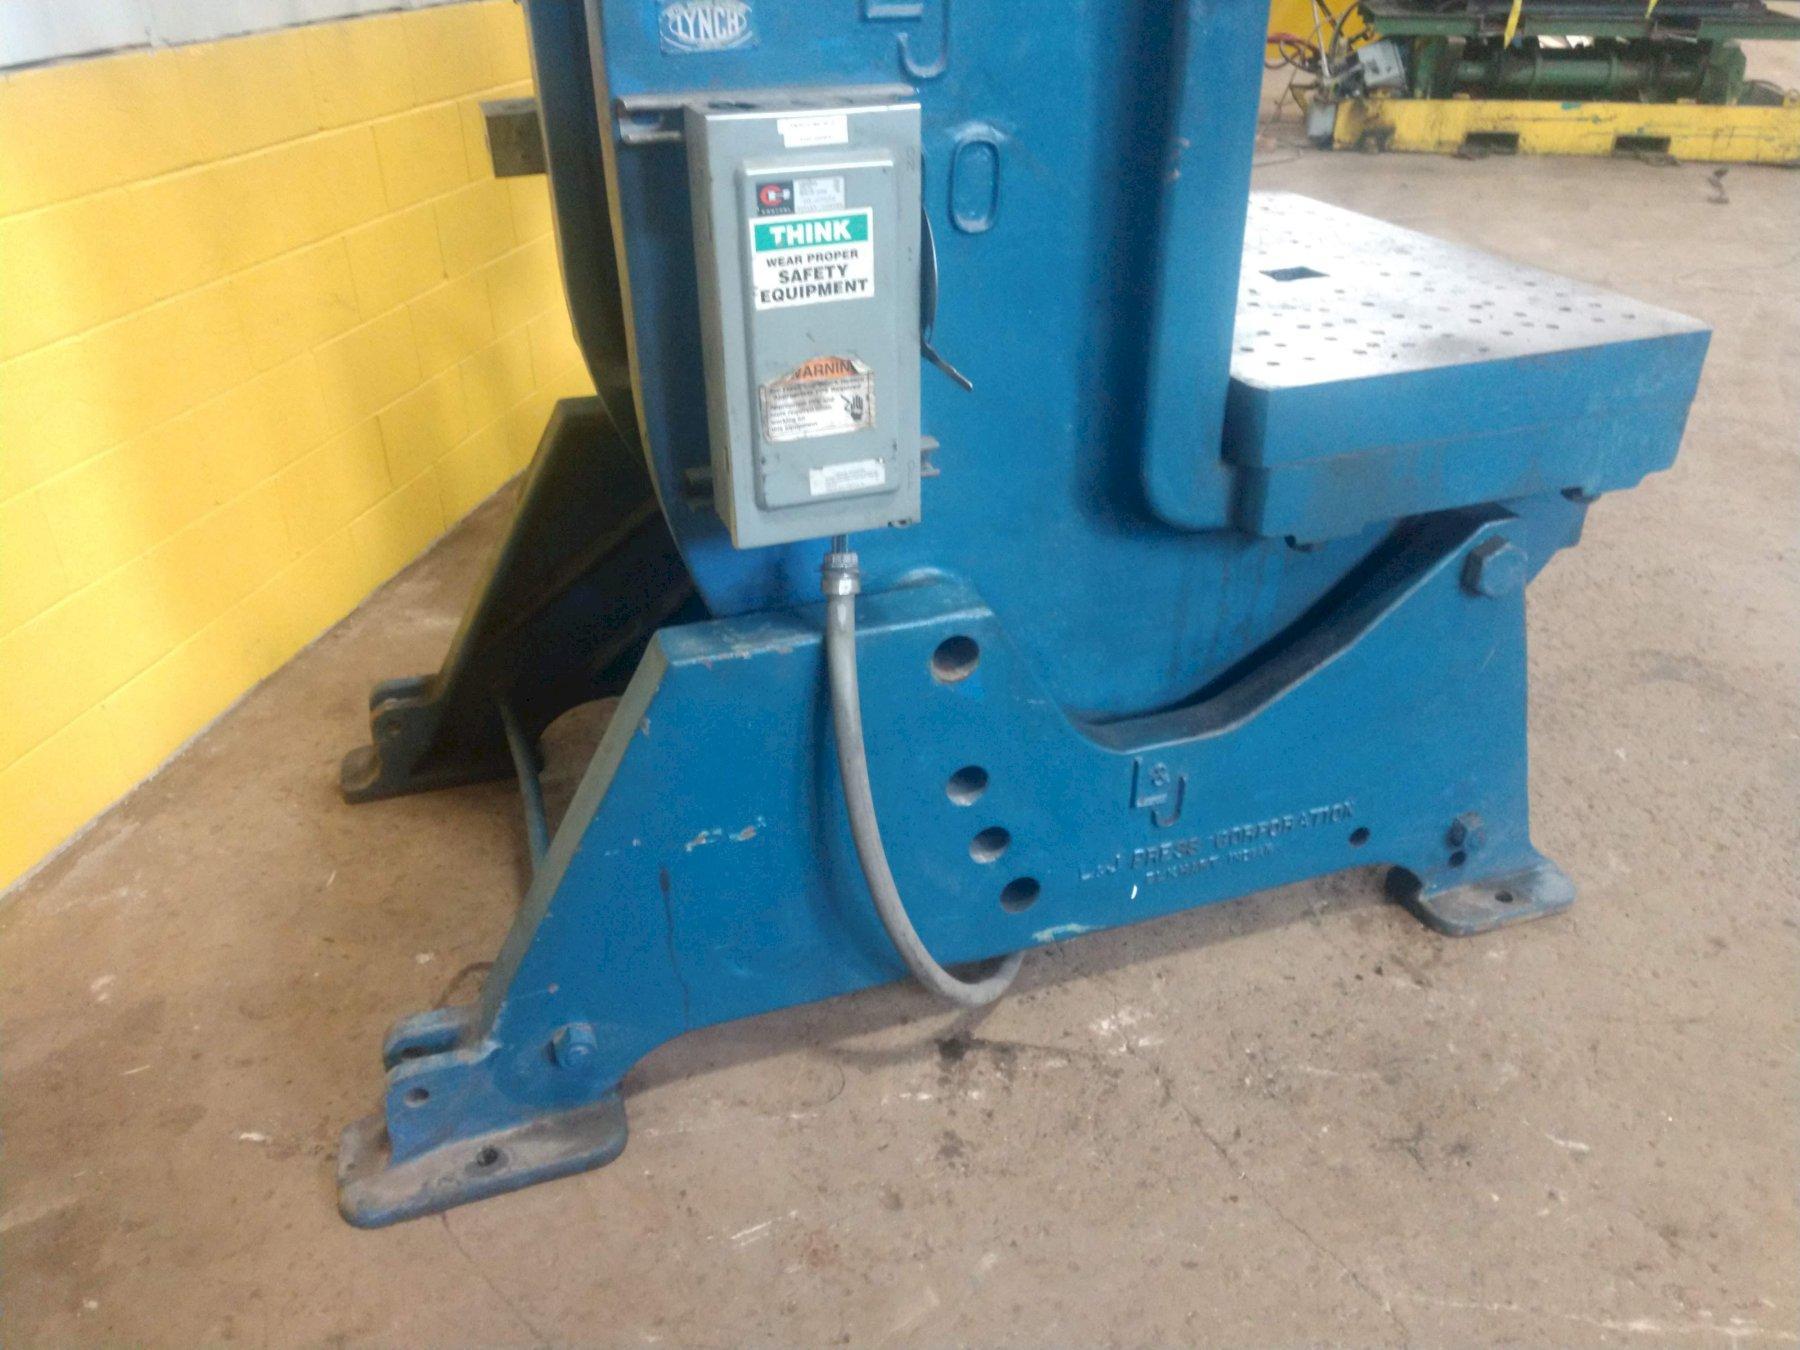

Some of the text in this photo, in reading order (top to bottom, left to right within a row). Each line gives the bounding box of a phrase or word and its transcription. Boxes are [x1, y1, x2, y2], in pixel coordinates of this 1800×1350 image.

[675, 5, 741, 42] LYNCH
[768, 219, 853, 248] THINK
[766, 248, 859, 268] WEAR PROPER
[778, 263, 848, 284] SAFETY
[760, 277, 869, 303] EQUIPMENT
[793, 361, 856, 378] ARNIN
